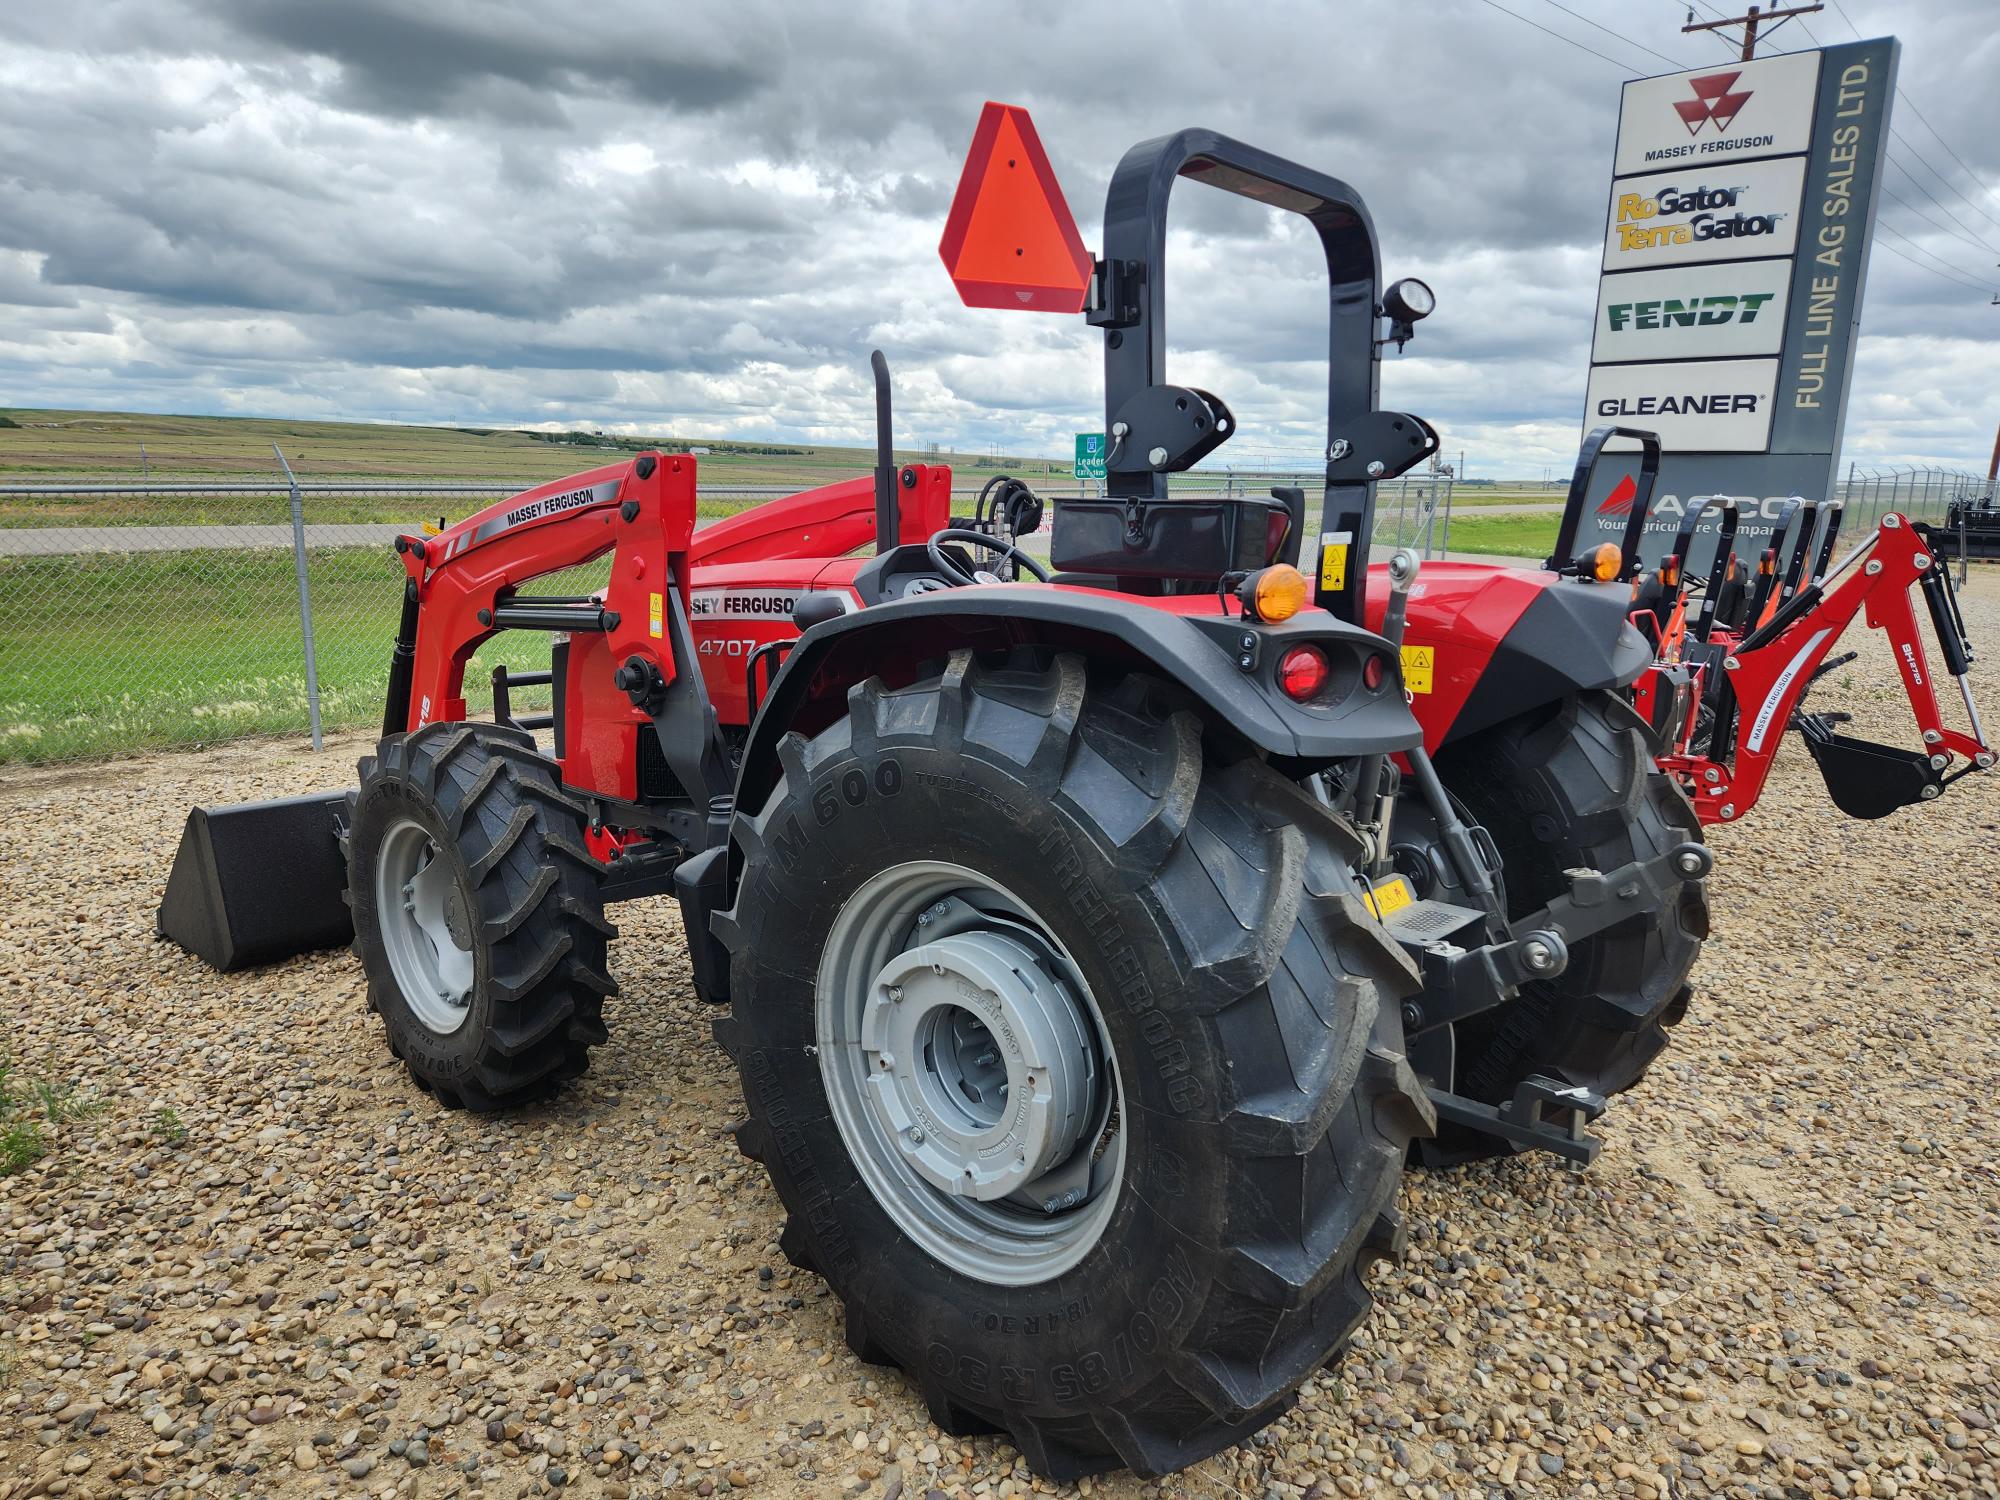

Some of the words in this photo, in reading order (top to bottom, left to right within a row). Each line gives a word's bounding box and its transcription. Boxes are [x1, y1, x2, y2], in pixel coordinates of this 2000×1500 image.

[1836, 57, 1871, 118] LTD.
[1644, 144, 1696, 162] MASSEY
[1700, 135, 1774, 154] FERGUSON
[1822, 124, 1860, 216] SALES
[1616, 185, 1745, 222] RoGator
[1615, 212, 1784, 251] TerraGator
[1815, 225, 1846, 268] AG
[1607, 293, 1775, 331] FENDT
[1805, 275, 1839, 337] LINE
[1795, 344, 1830, 408] FULL
[1597, 394, 1758, 417] GLEANER
[1077, 457, 1104, 467] Leader
[507, 503, 542, 527] MASSEY
[544, 489, 594, 513] FERGUSON
[723, 597, 799, 614] FERGUSO
[699, 640, 756, 657] 4707
[1753, 708, 1771, 740] MASSEY
[1767, 671, 1793, 708] FERGUSON
[811, 758, 904, 828] 600
[914, 770, 1023, 821] TUBELESS
[1039, 815, 1203, 1114] TRELLEBORG
[926, 1342, 989, 1393] 30
[1000, 1364, 1039, 1403] R
